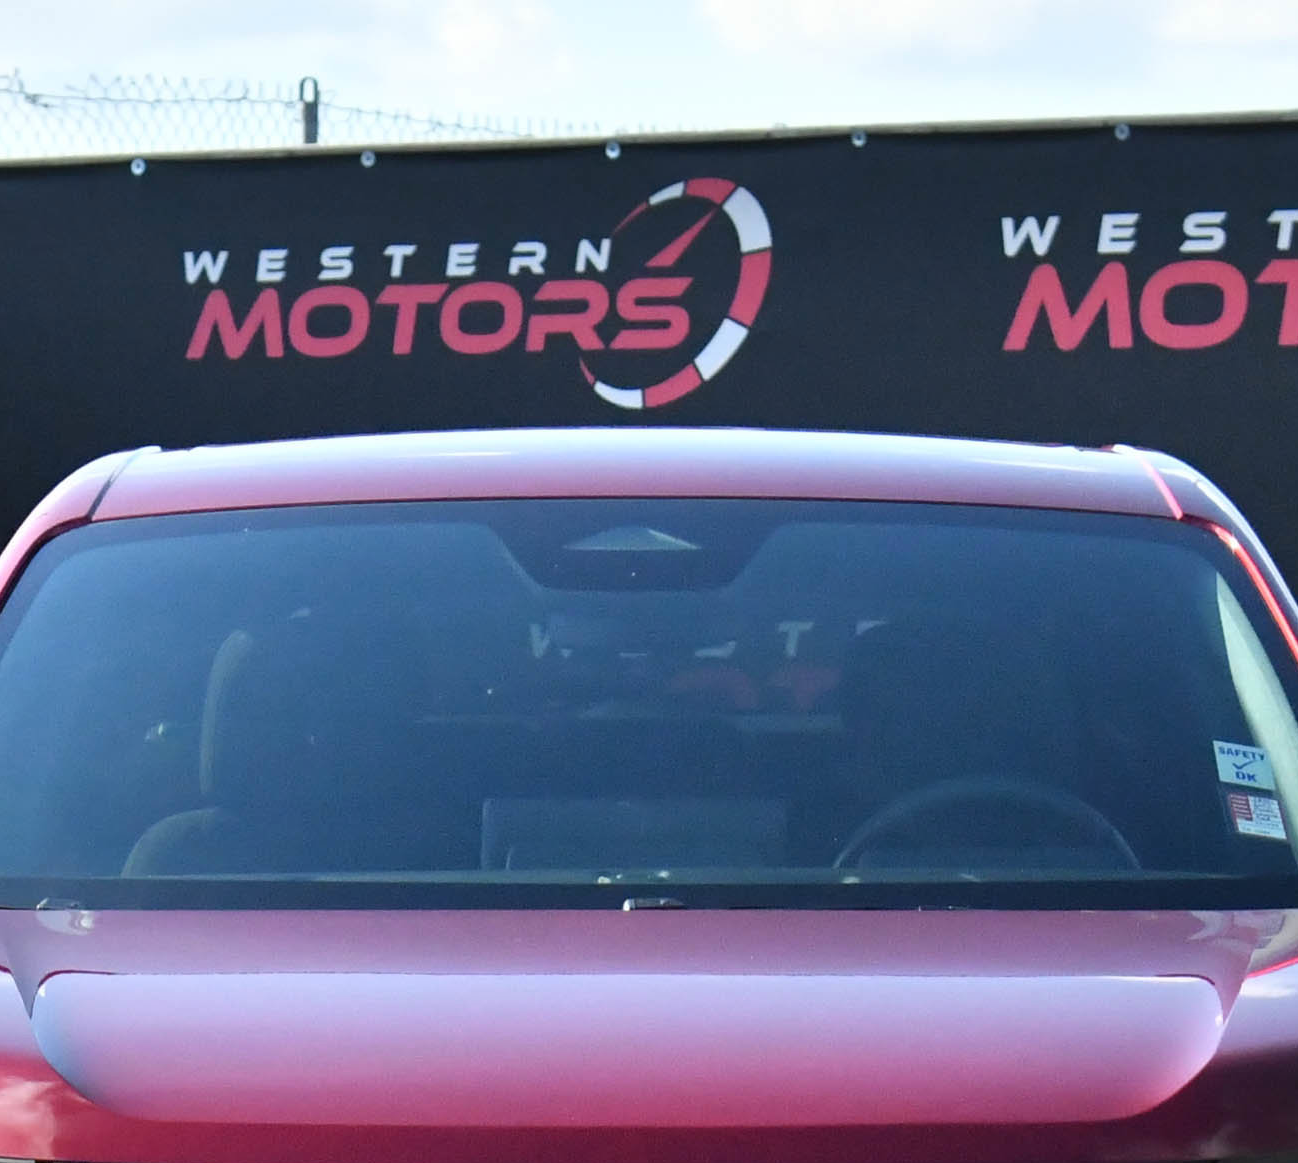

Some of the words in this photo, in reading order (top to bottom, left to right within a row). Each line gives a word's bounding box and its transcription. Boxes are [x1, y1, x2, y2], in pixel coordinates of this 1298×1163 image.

[183, 238, 612, 285] WESTERN
[186, 277, 694, 359] MOTORS
[1218, 746, 1266, 761] SAFETY
[1235, 771, 1257, 783] OK
